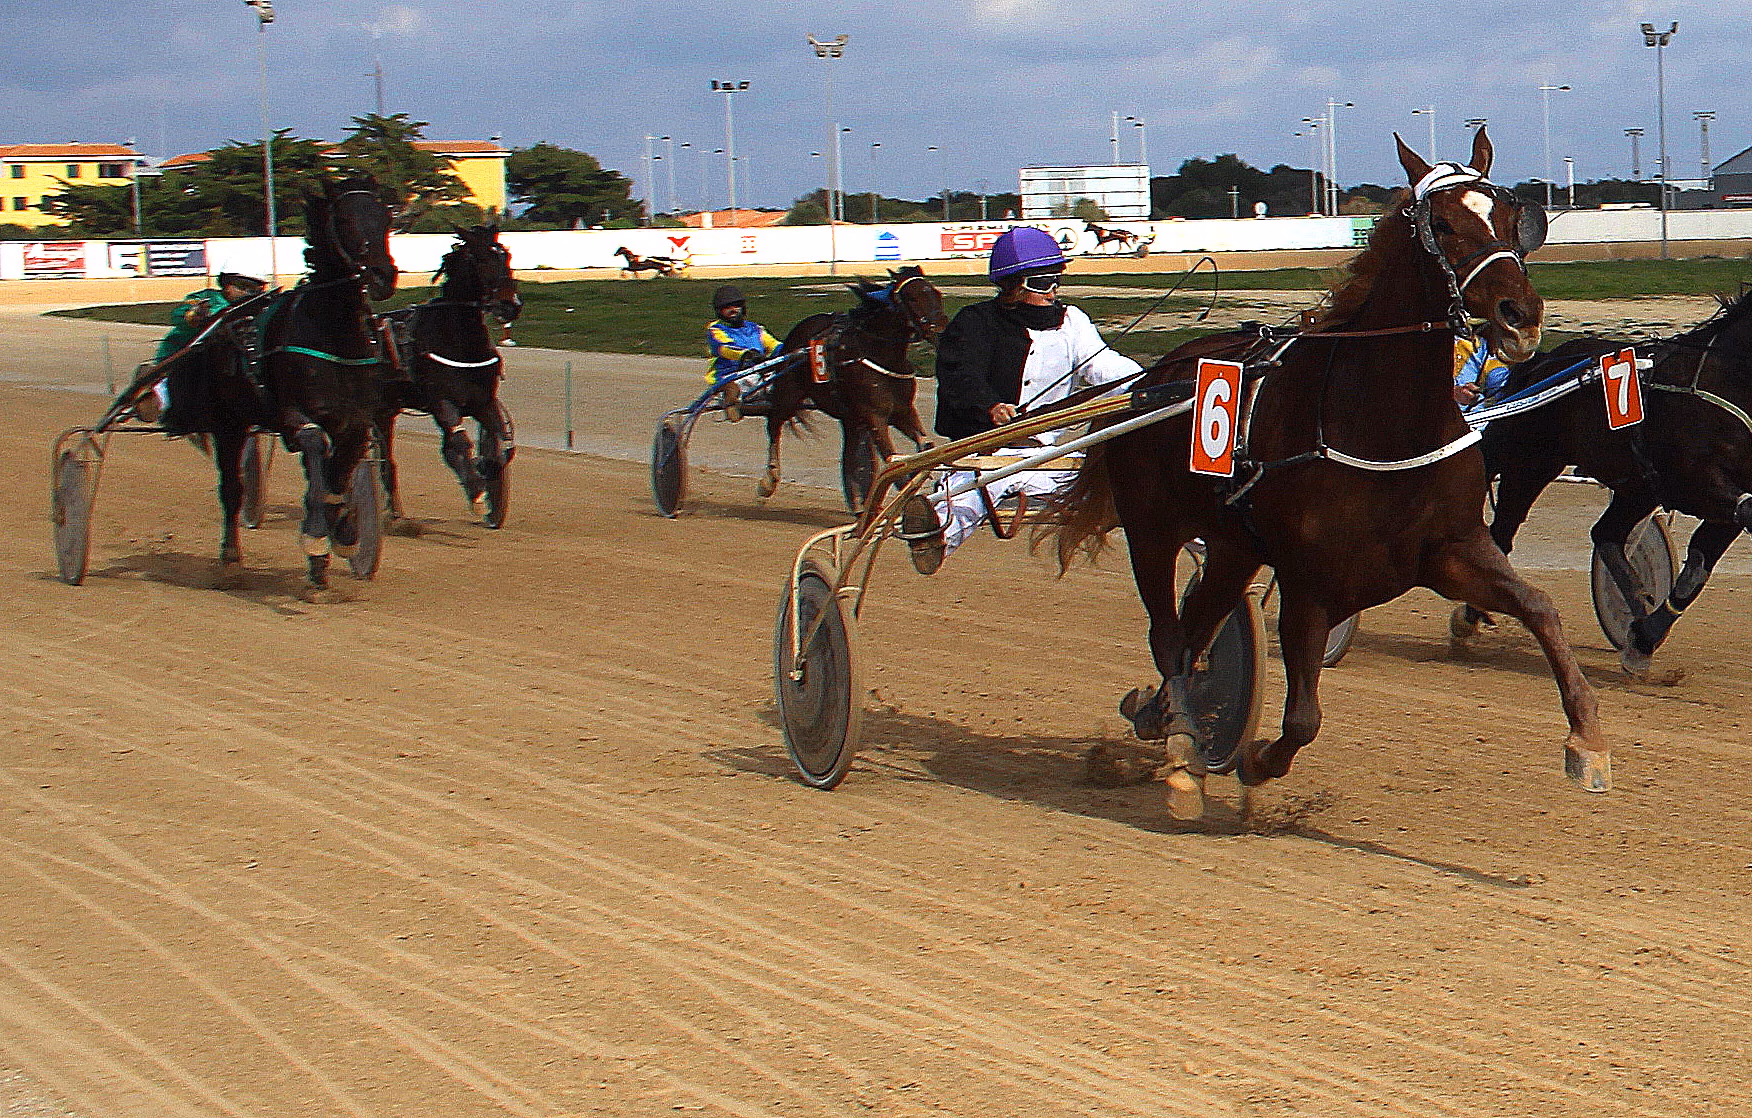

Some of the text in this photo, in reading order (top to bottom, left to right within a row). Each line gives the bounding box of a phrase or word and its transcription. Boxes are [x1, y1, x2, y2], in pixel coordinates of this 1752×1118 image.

[815, 344, 825, 375] 5
[1608, 361, 1631, 416] 7
[1201, 378, 1231, 458] 6
